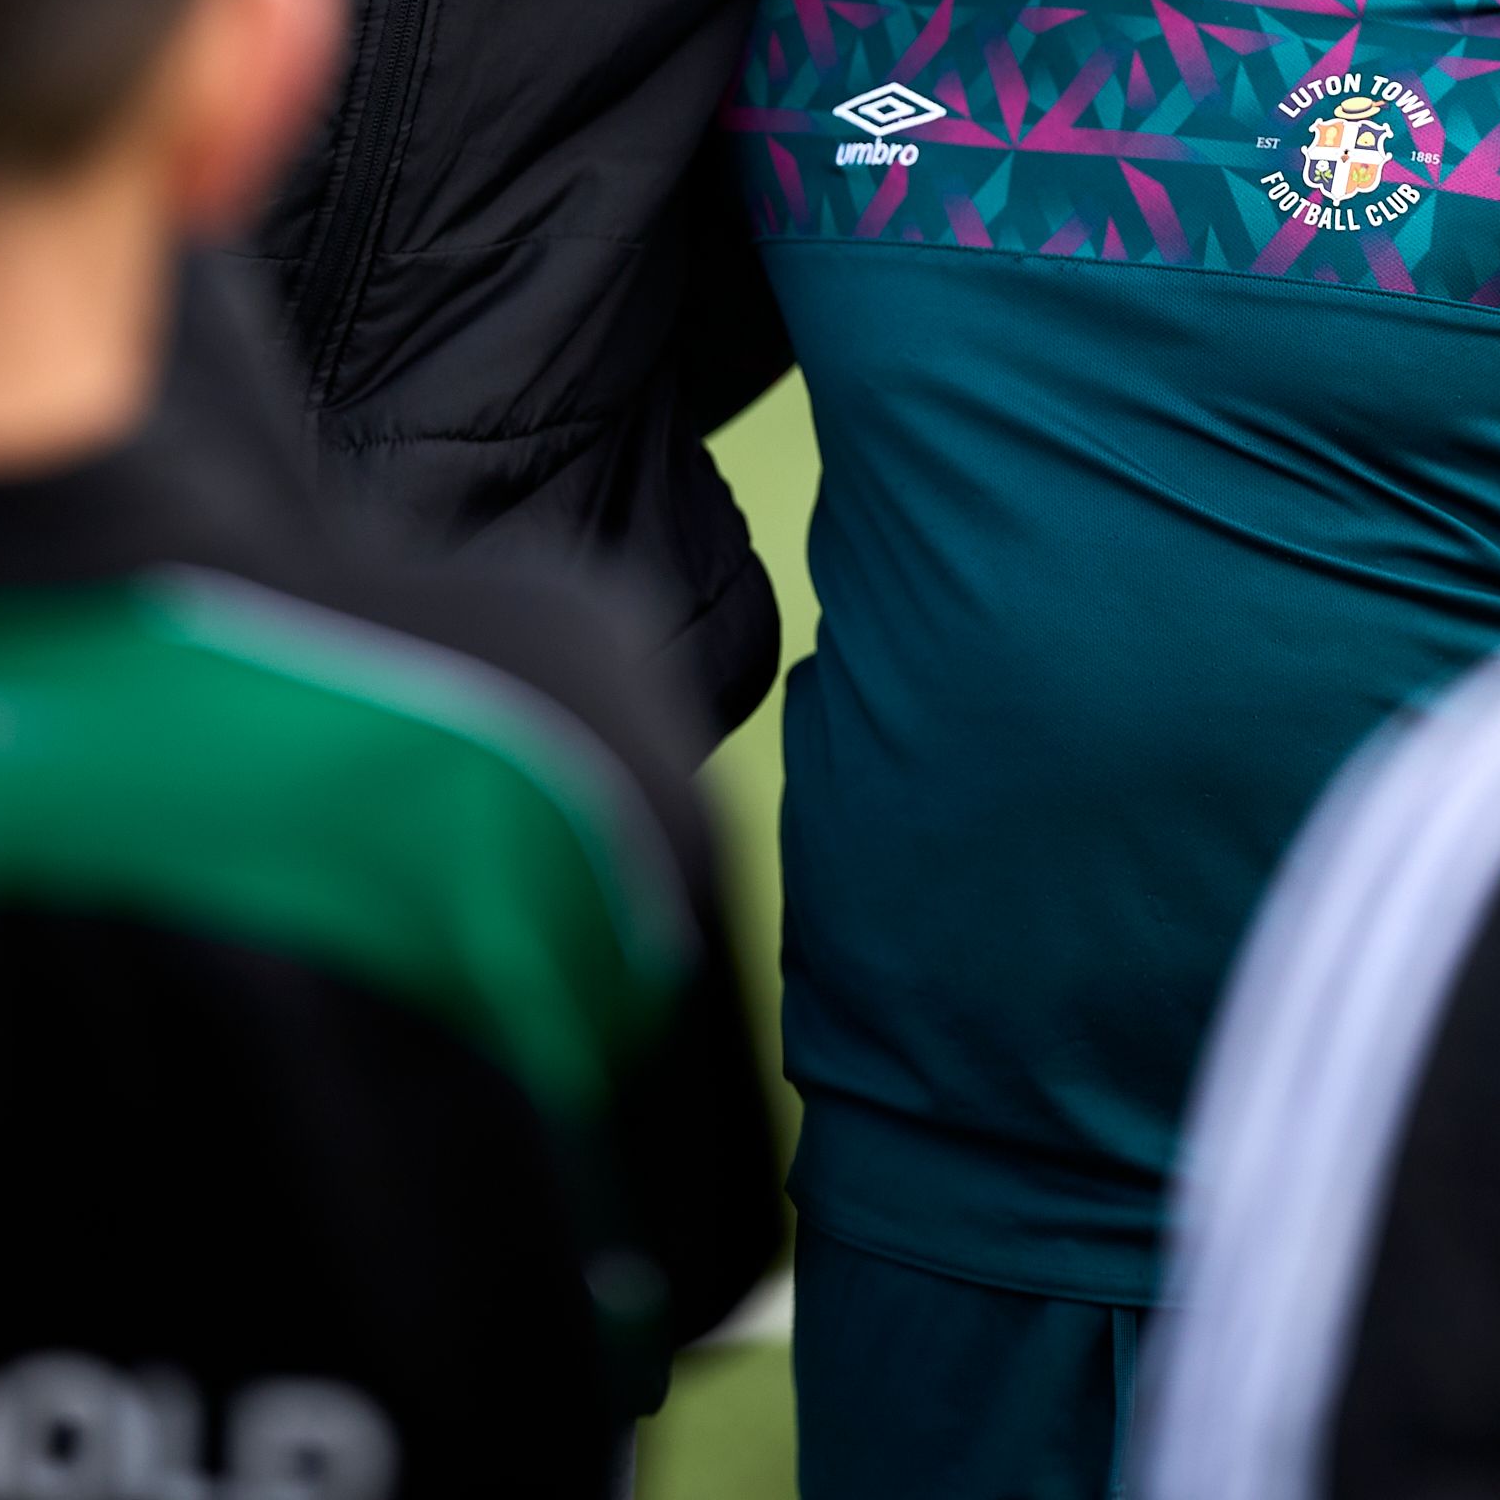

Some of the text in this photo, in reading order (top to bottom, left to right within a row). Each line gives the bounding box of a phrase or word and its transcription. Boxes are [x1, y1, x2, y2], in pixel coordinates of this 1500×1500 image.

[1277, 73, 1435, 129] LUTON TOWN
[835, 135, 920, 167] umbro
[1256, 136, 1441, 165] EST 1885
[1260, 171, 1421, 231] FOOTBALL CLUB
